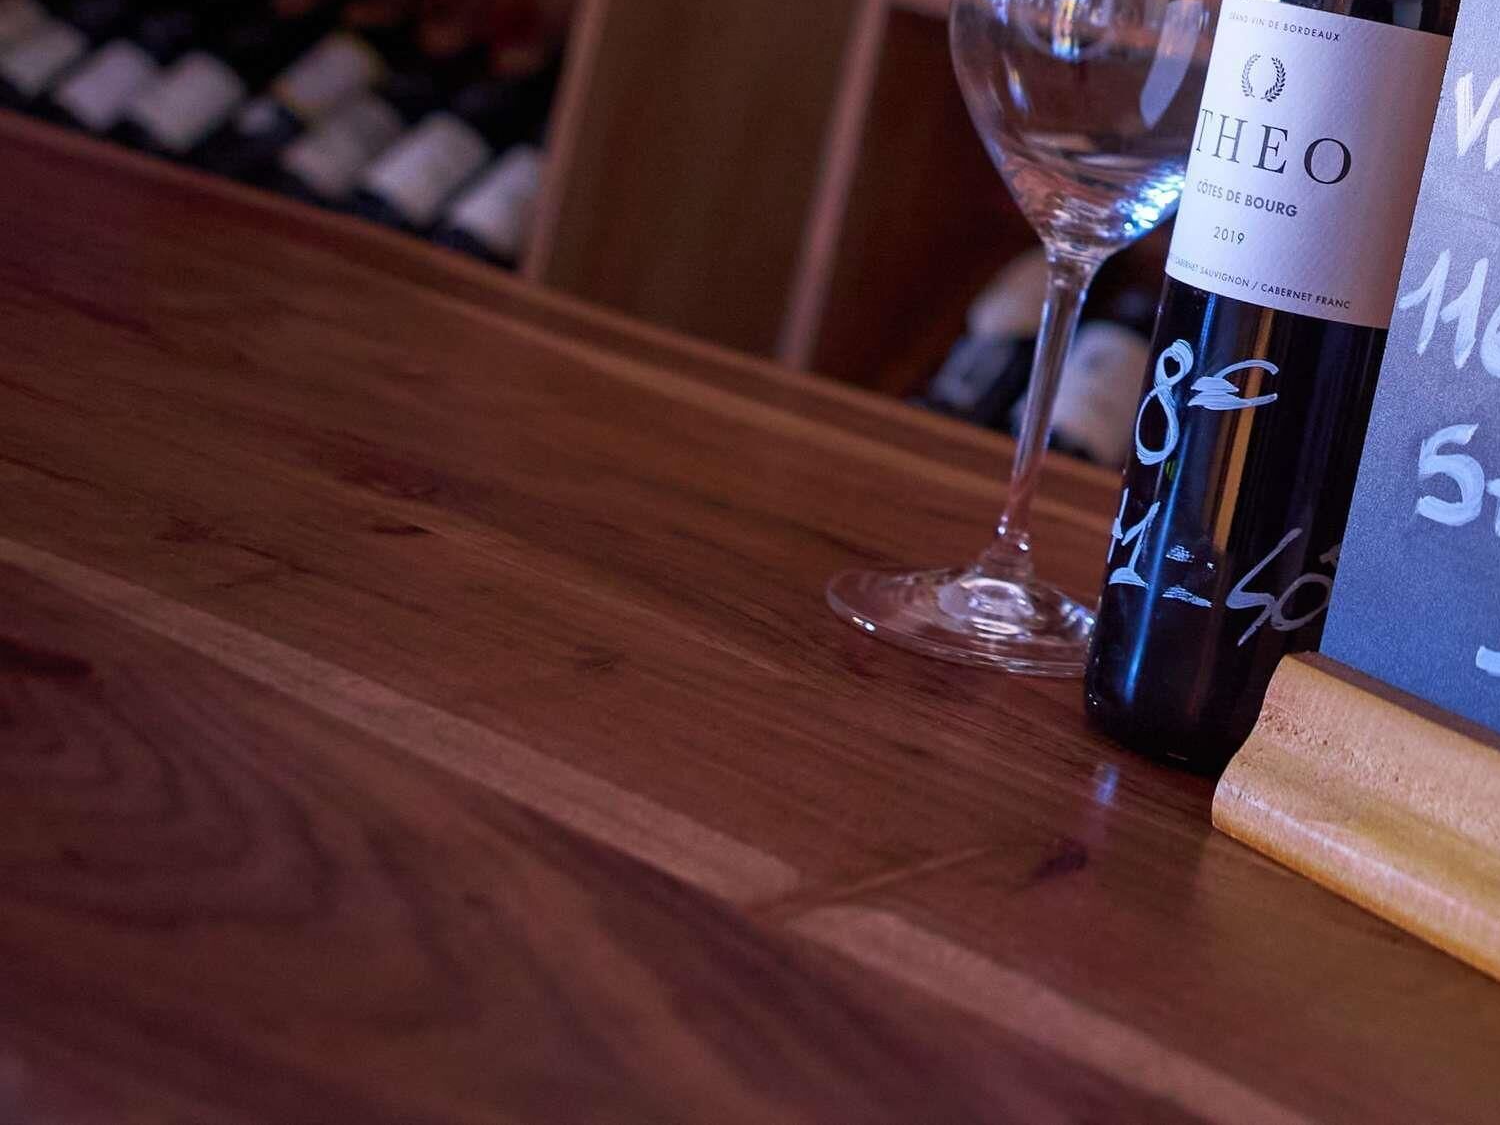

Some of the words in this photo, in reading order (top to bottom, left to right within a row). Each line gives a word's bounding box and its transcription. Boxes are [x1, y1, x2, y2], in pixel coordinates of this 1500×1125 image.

[1251, 17, 1265, 28] VIN
[1268, 19, 1280, 30] DE
[1282, 22, 1341, 42] BORDEAUX
[1195, 108, 1352, 185] THEO
[1226, 189, 1242, 205] DE
[1244, 194, 1299, 218] BOURG
[1213, 225, 1246, 245] 2019
[1200, 266, 1251, 288] SAUVIGNON
[1260, 283, 1315, 303] CABERNET
[1315, 294, 1352, 310] FRANC
